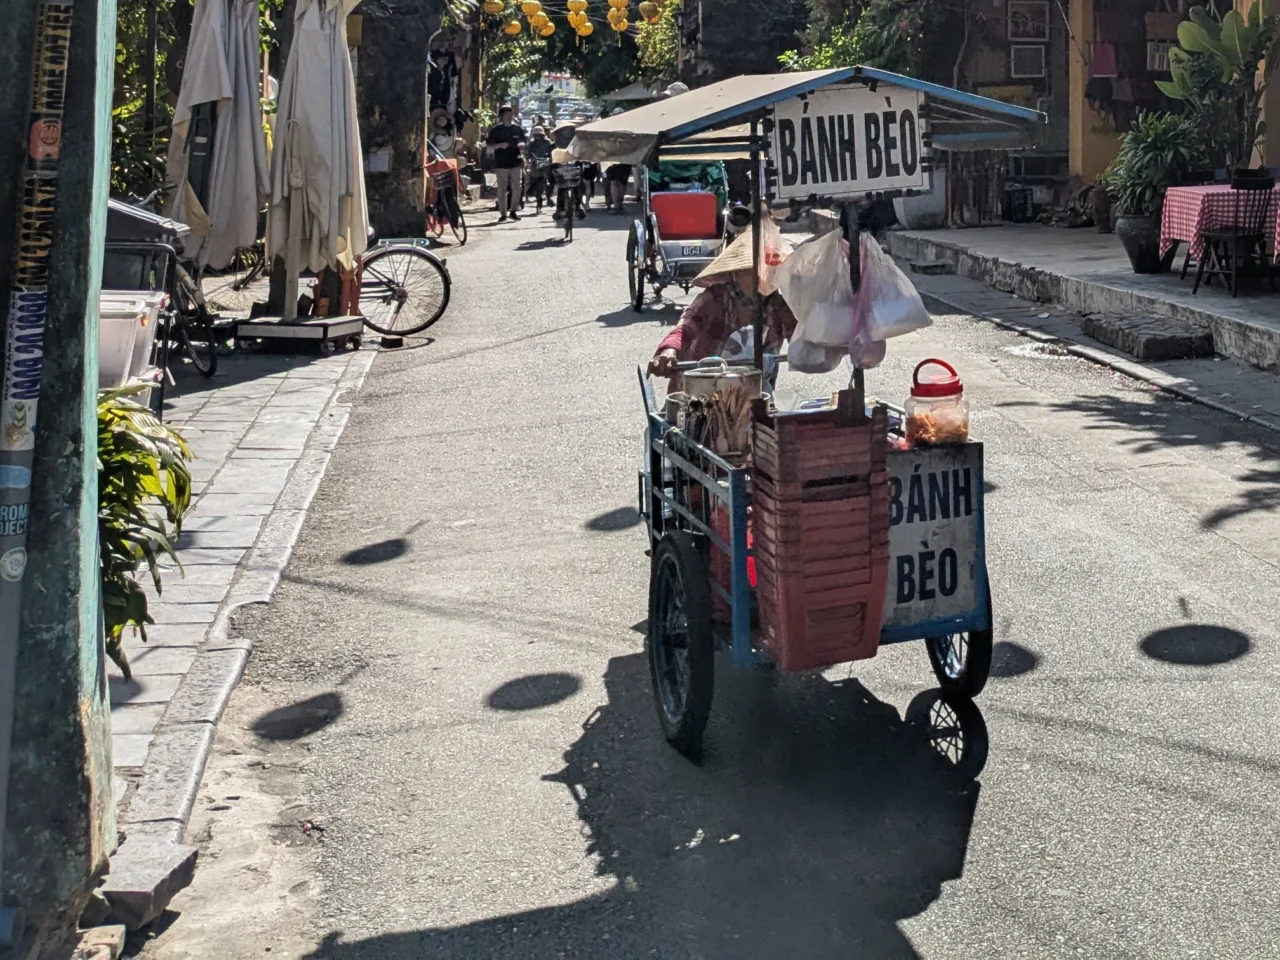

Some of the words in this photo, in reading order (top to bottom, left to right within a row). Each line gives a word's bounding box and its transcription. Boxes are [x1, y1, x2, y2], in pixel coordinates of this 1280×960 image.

[778, 101, 857, 187] BÁNH
[864, 96, 918, 179] BÈO
[683, 246, 700, 256] 054
[888, 463, 973, 526] BÁNH
[896, 540, 958, 604] BÈO
